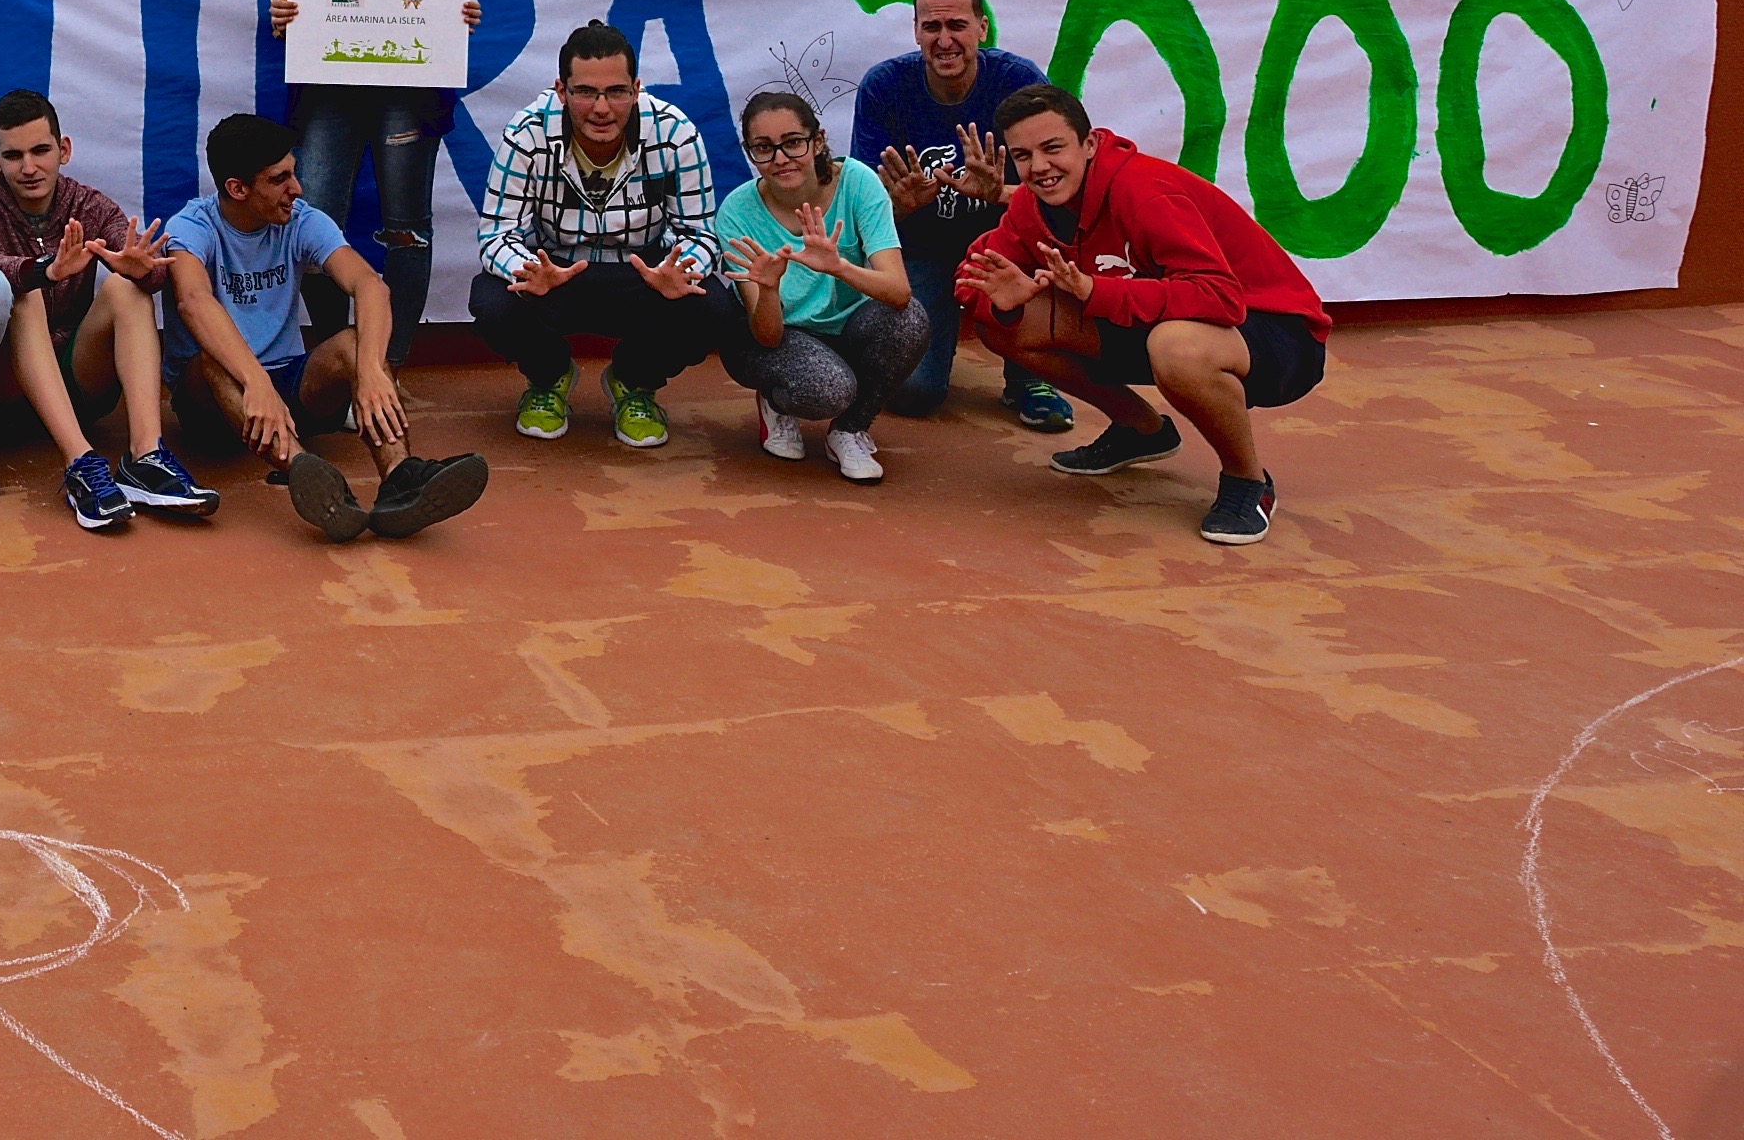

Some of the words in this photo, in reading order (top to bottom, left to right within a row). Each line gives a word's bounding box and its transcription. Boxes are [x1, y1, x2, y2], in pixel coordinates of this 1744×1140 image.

[325, 12, 348, 23] ÁREA
[349, 15, 385, 24] MARINA
[386, 16, 398, 25] LA
[399, 16, 427, 25] ISLETA
